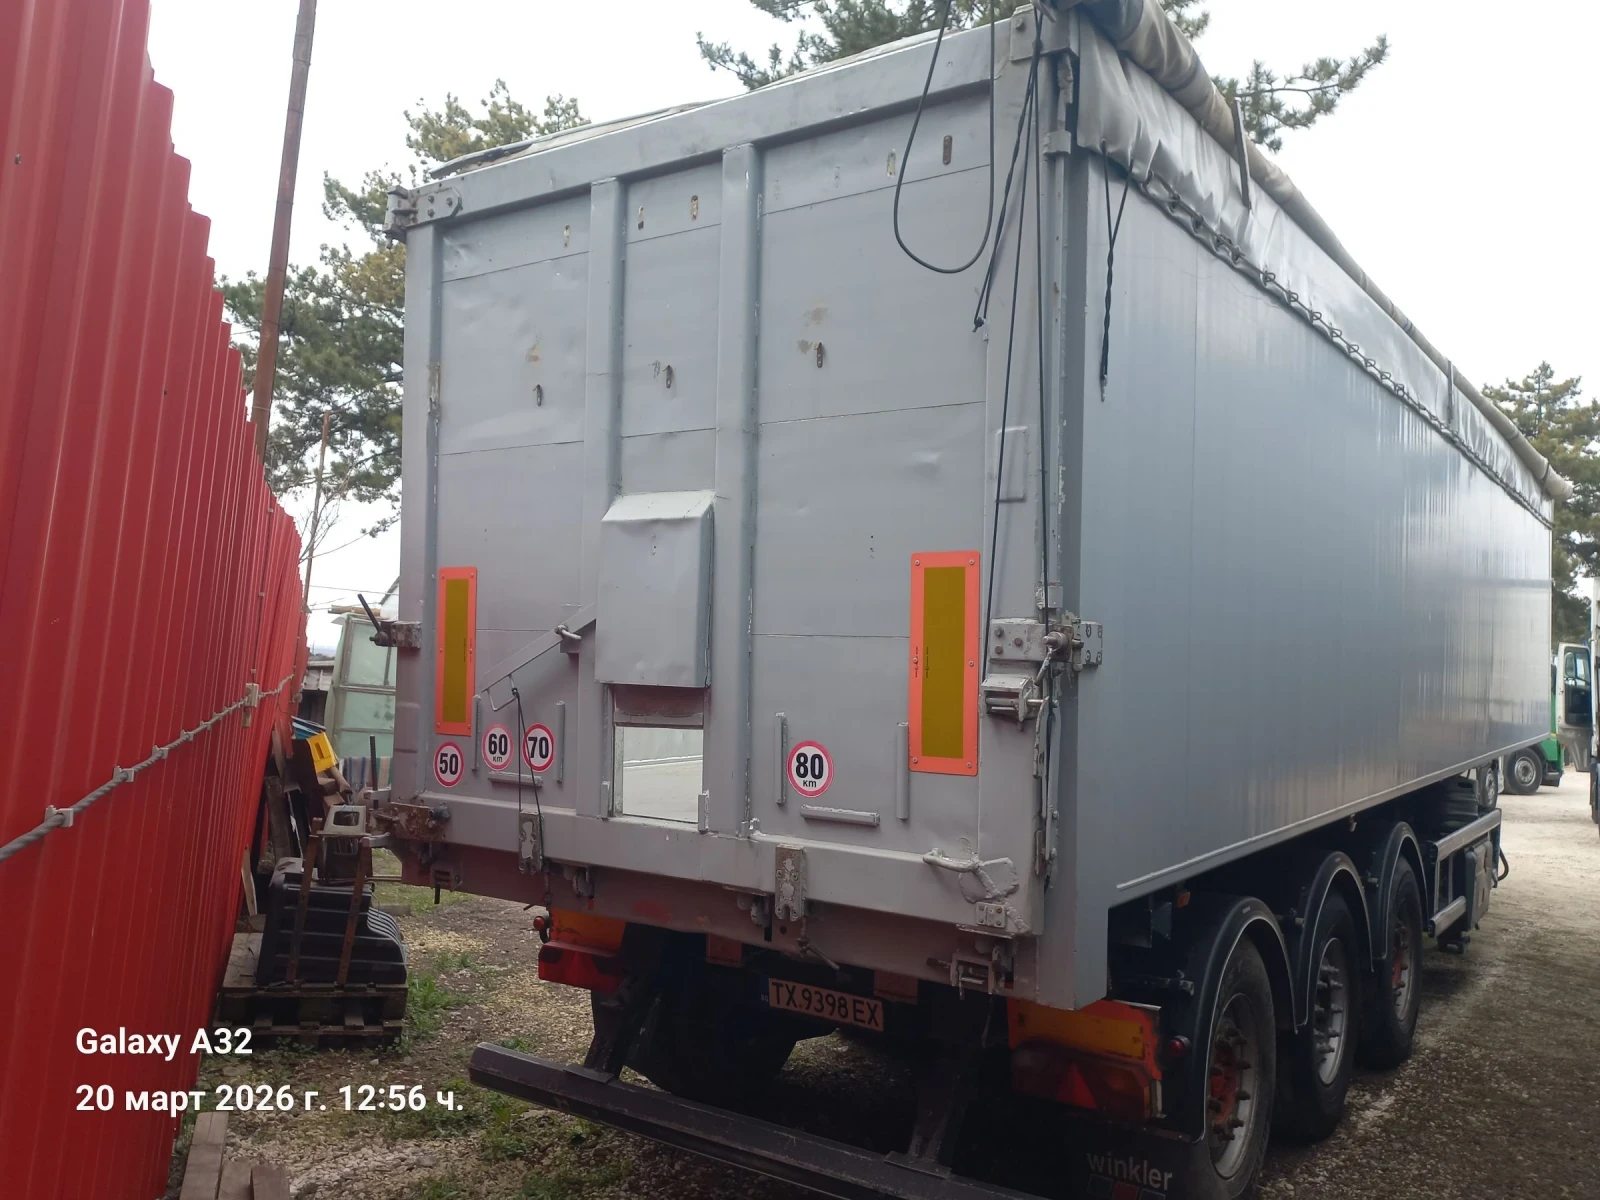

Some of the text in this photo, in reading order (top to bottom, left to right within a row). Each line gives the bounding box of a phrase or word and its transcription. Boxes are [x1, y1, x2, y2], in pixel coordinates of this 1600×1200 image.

[487, 733, 508, 755] 60
[527, 736, 549, 759] 70
[439, 752, 459, 775] 50
[795, 752, 824, 780] 80
[1085, 1151, 1173, 1191] winkler
